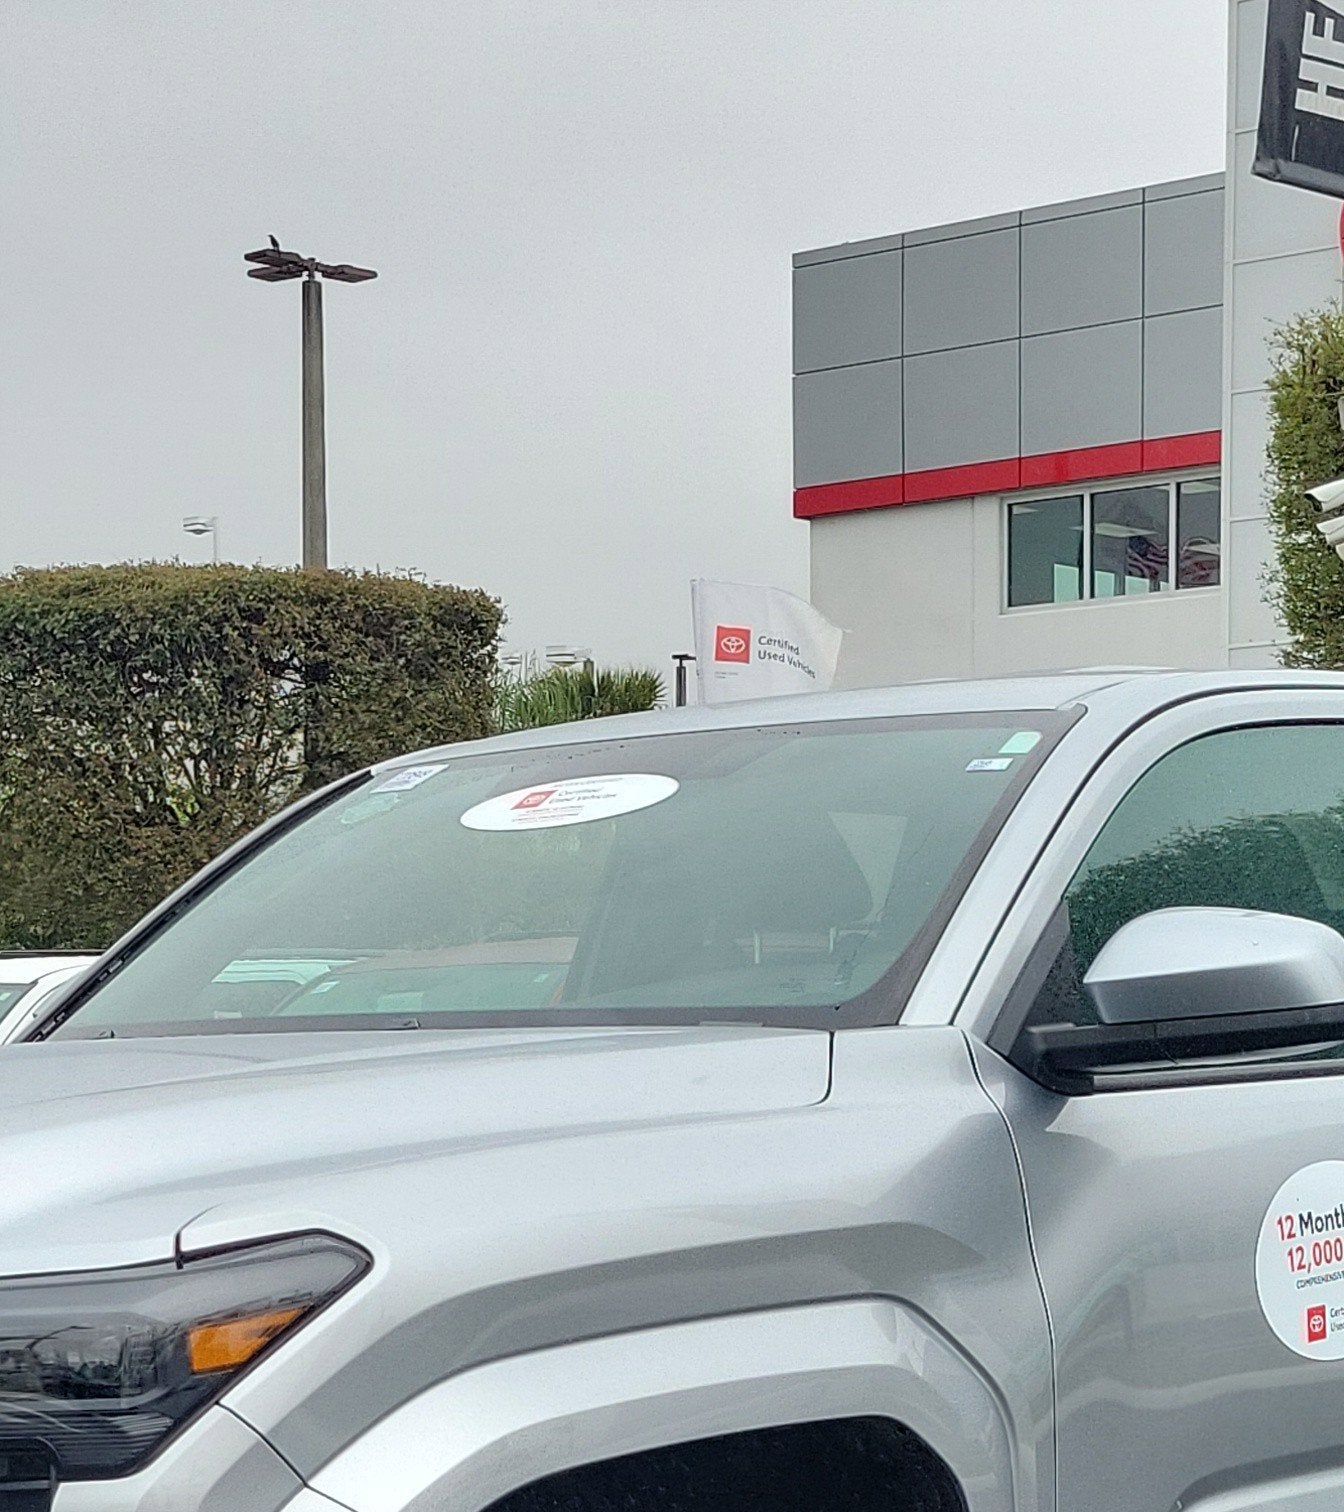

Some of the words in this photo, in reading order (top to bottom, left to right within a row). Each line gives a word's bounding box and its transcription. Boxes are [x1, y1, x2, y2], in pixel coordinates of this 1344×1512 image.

[758, 650, 785, 663] Used
[1277, 1214, 1296, 1241] 12
[1287, 1237, 1344, 1273] 12,000
